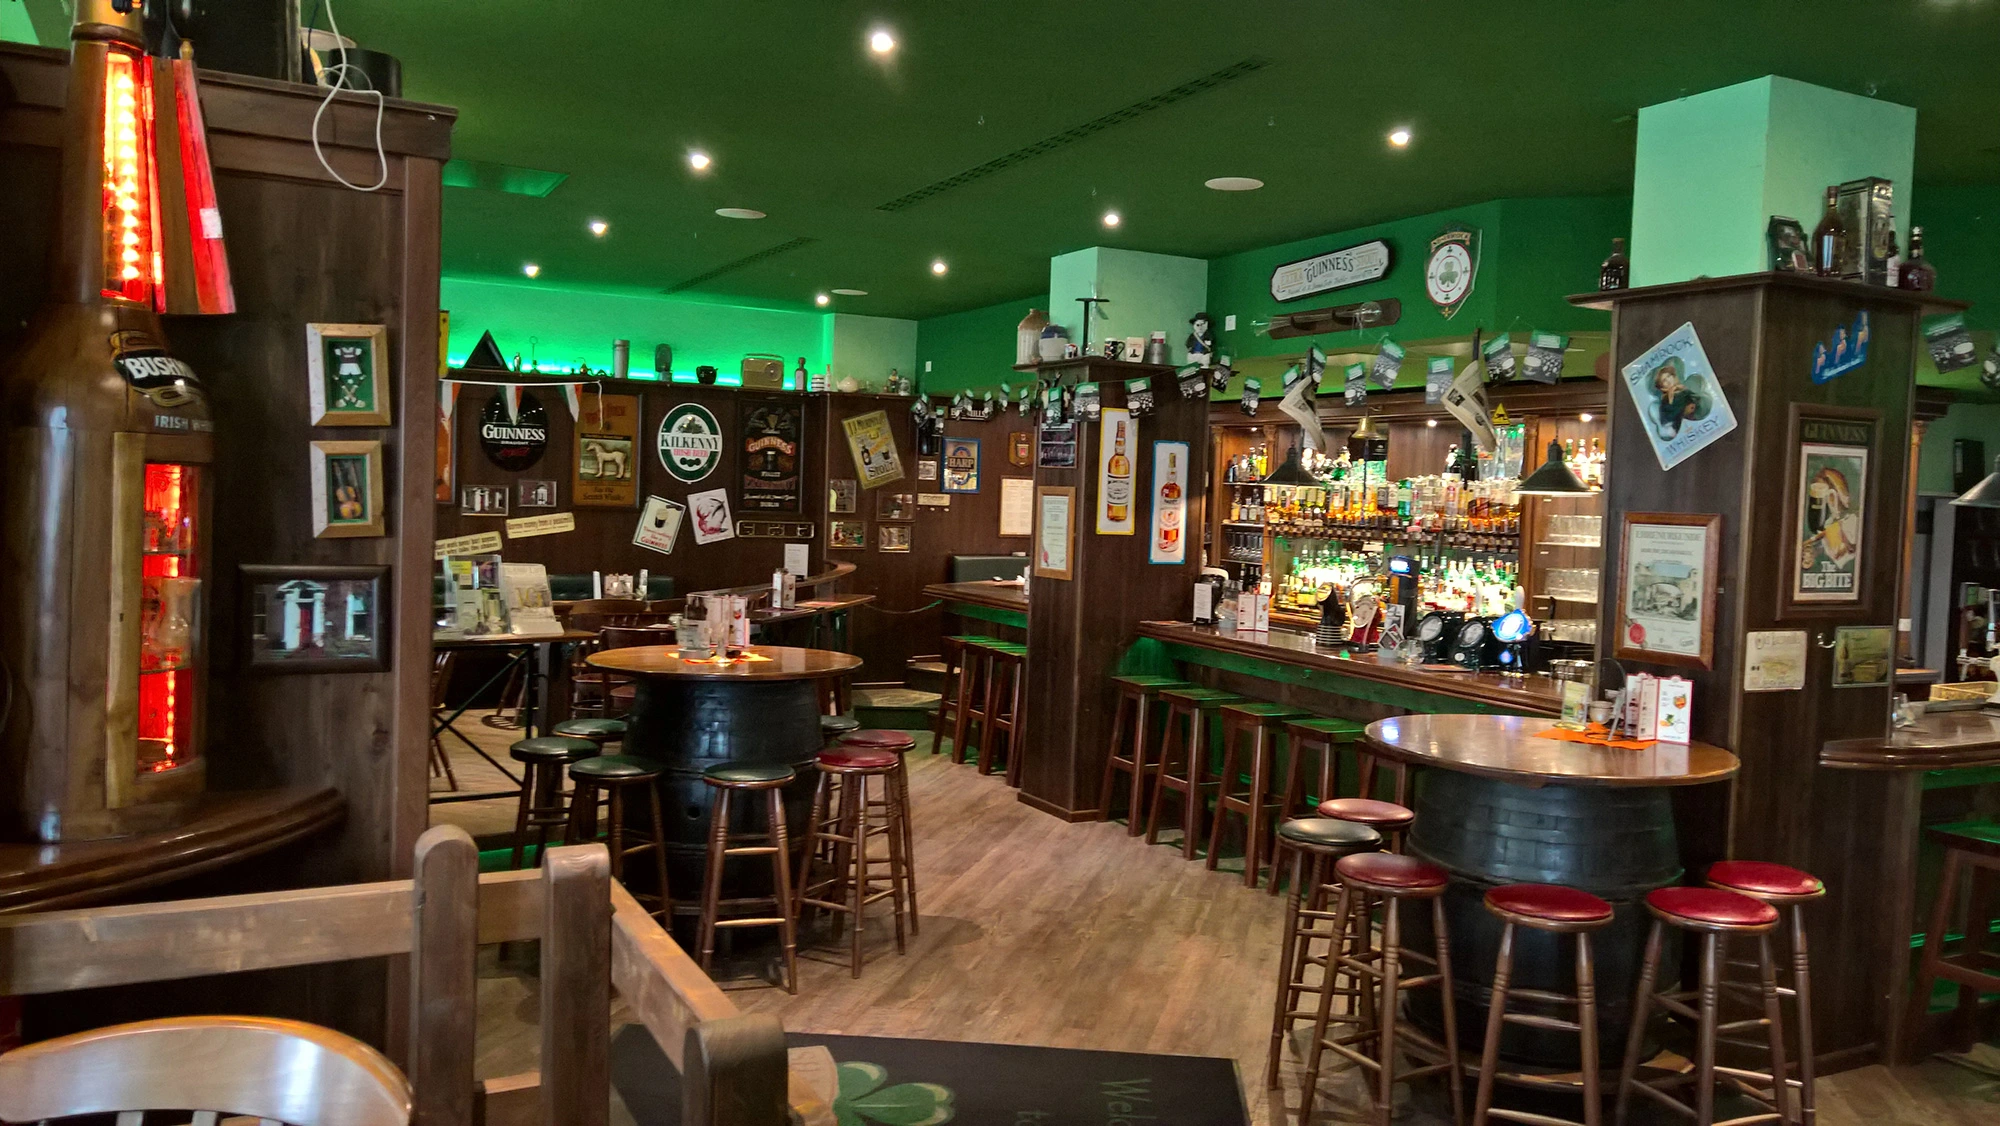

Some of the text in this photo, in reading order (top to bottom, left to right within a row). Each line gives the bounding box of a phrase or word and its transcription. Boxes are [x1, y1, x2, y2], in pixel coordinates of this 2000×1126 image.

[1306, 257, 1353, 283] GUINNESS
[1630, 337, 1693, 385] SHAMROCK
[154, 415, 188, 430] IRISH
[481, 424, 546, 441] GUINNESS
[1666, 416, 1718, 455] WHISKEY
[1804, 423, 1868, 442] GUINNESS
[660, 434, 719, 449] KILKENNY
[748, 436, 792, 455] GUINNESS
[868, 462, 895, 477] STOUT
[949, 458, 974, 469] HARP
[1820, 561, 1836, 572] The
